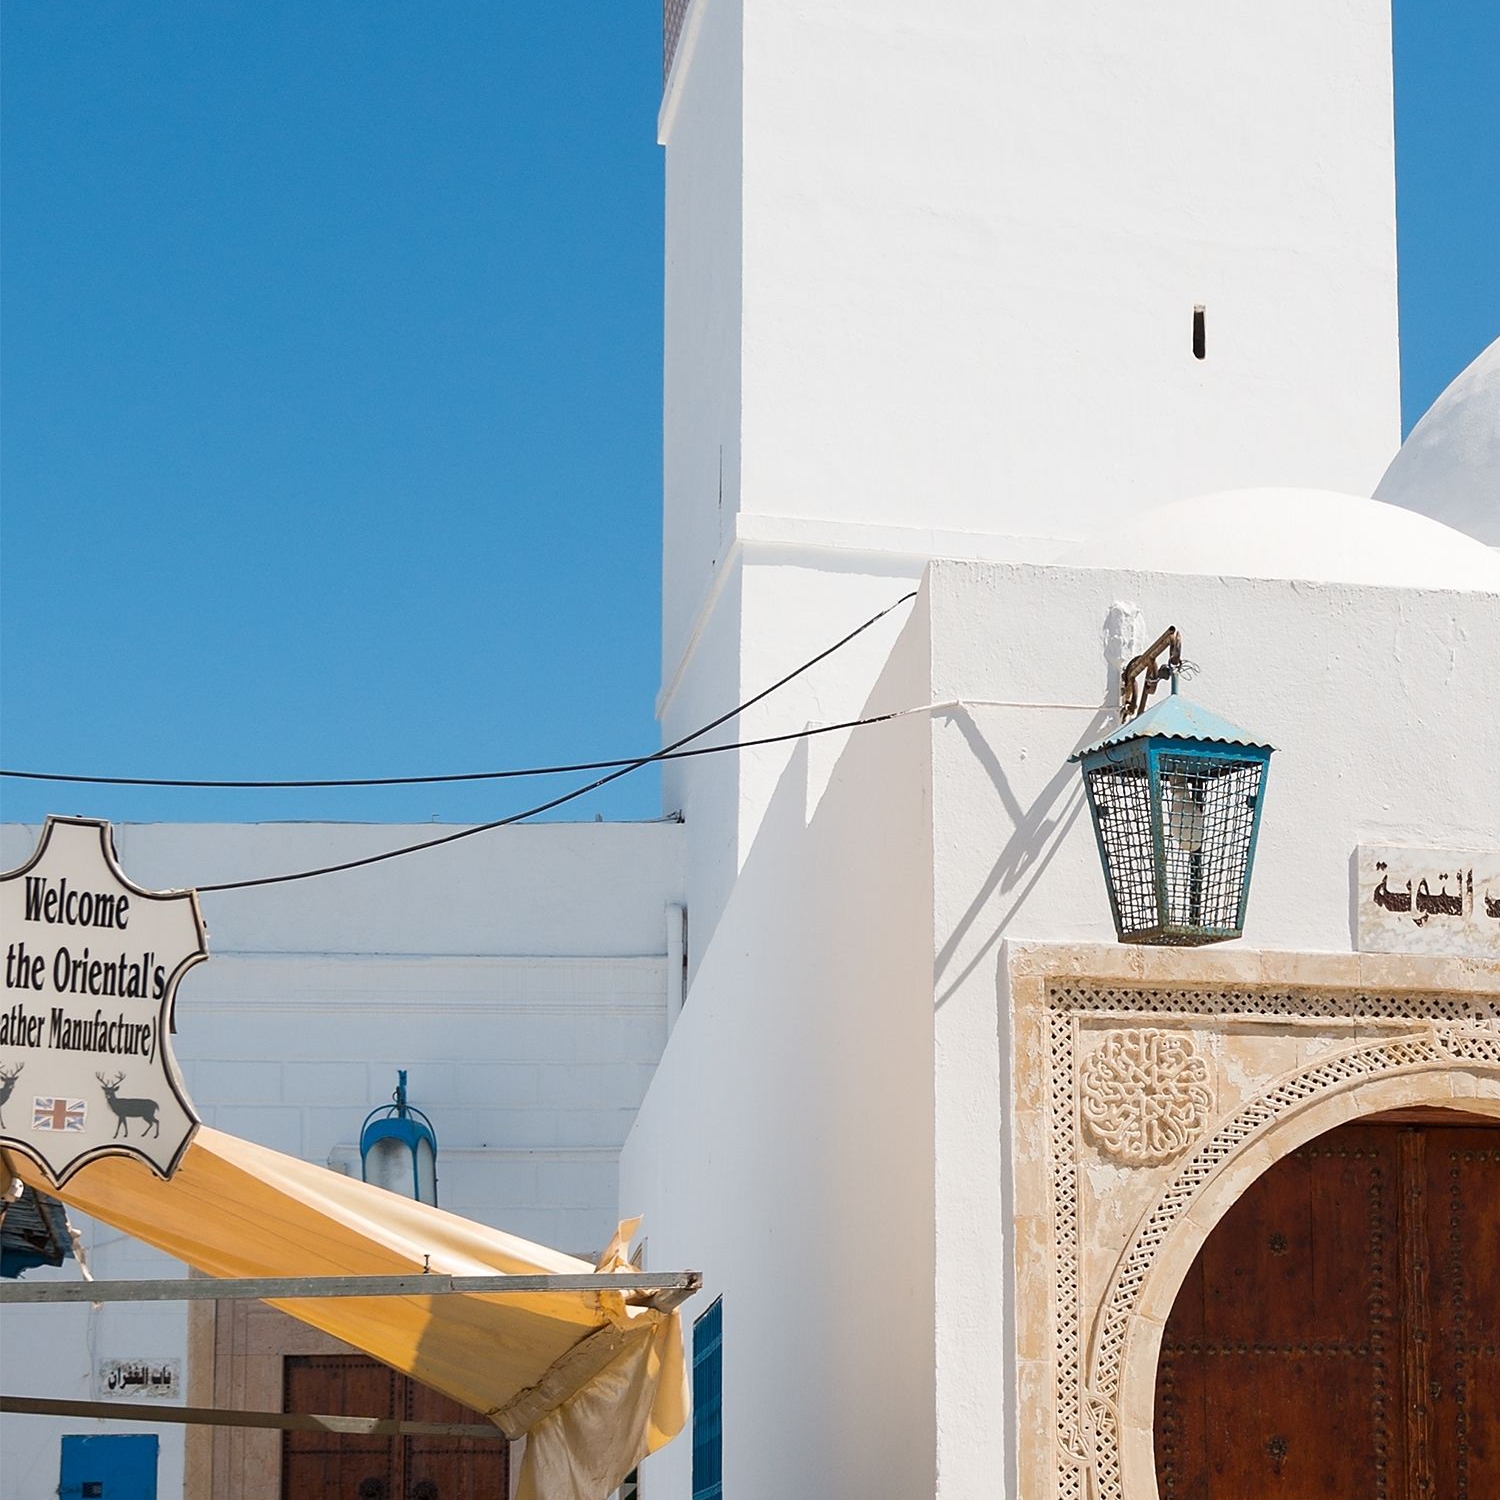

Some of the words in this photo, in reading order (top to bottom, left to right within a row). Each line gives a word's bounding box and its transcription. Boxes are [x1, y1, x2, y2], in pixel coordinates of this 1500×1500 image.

[24, 876, 130, 930] Welcome
[1373, 861, 1473, 928] التوبة
[6, 942, 46, 991] the
[53, 946, 165, 1000] Oriental's
[48, 1007, 157, 1064] Manufacture)
[152, 1366, 171, 1389] باب
